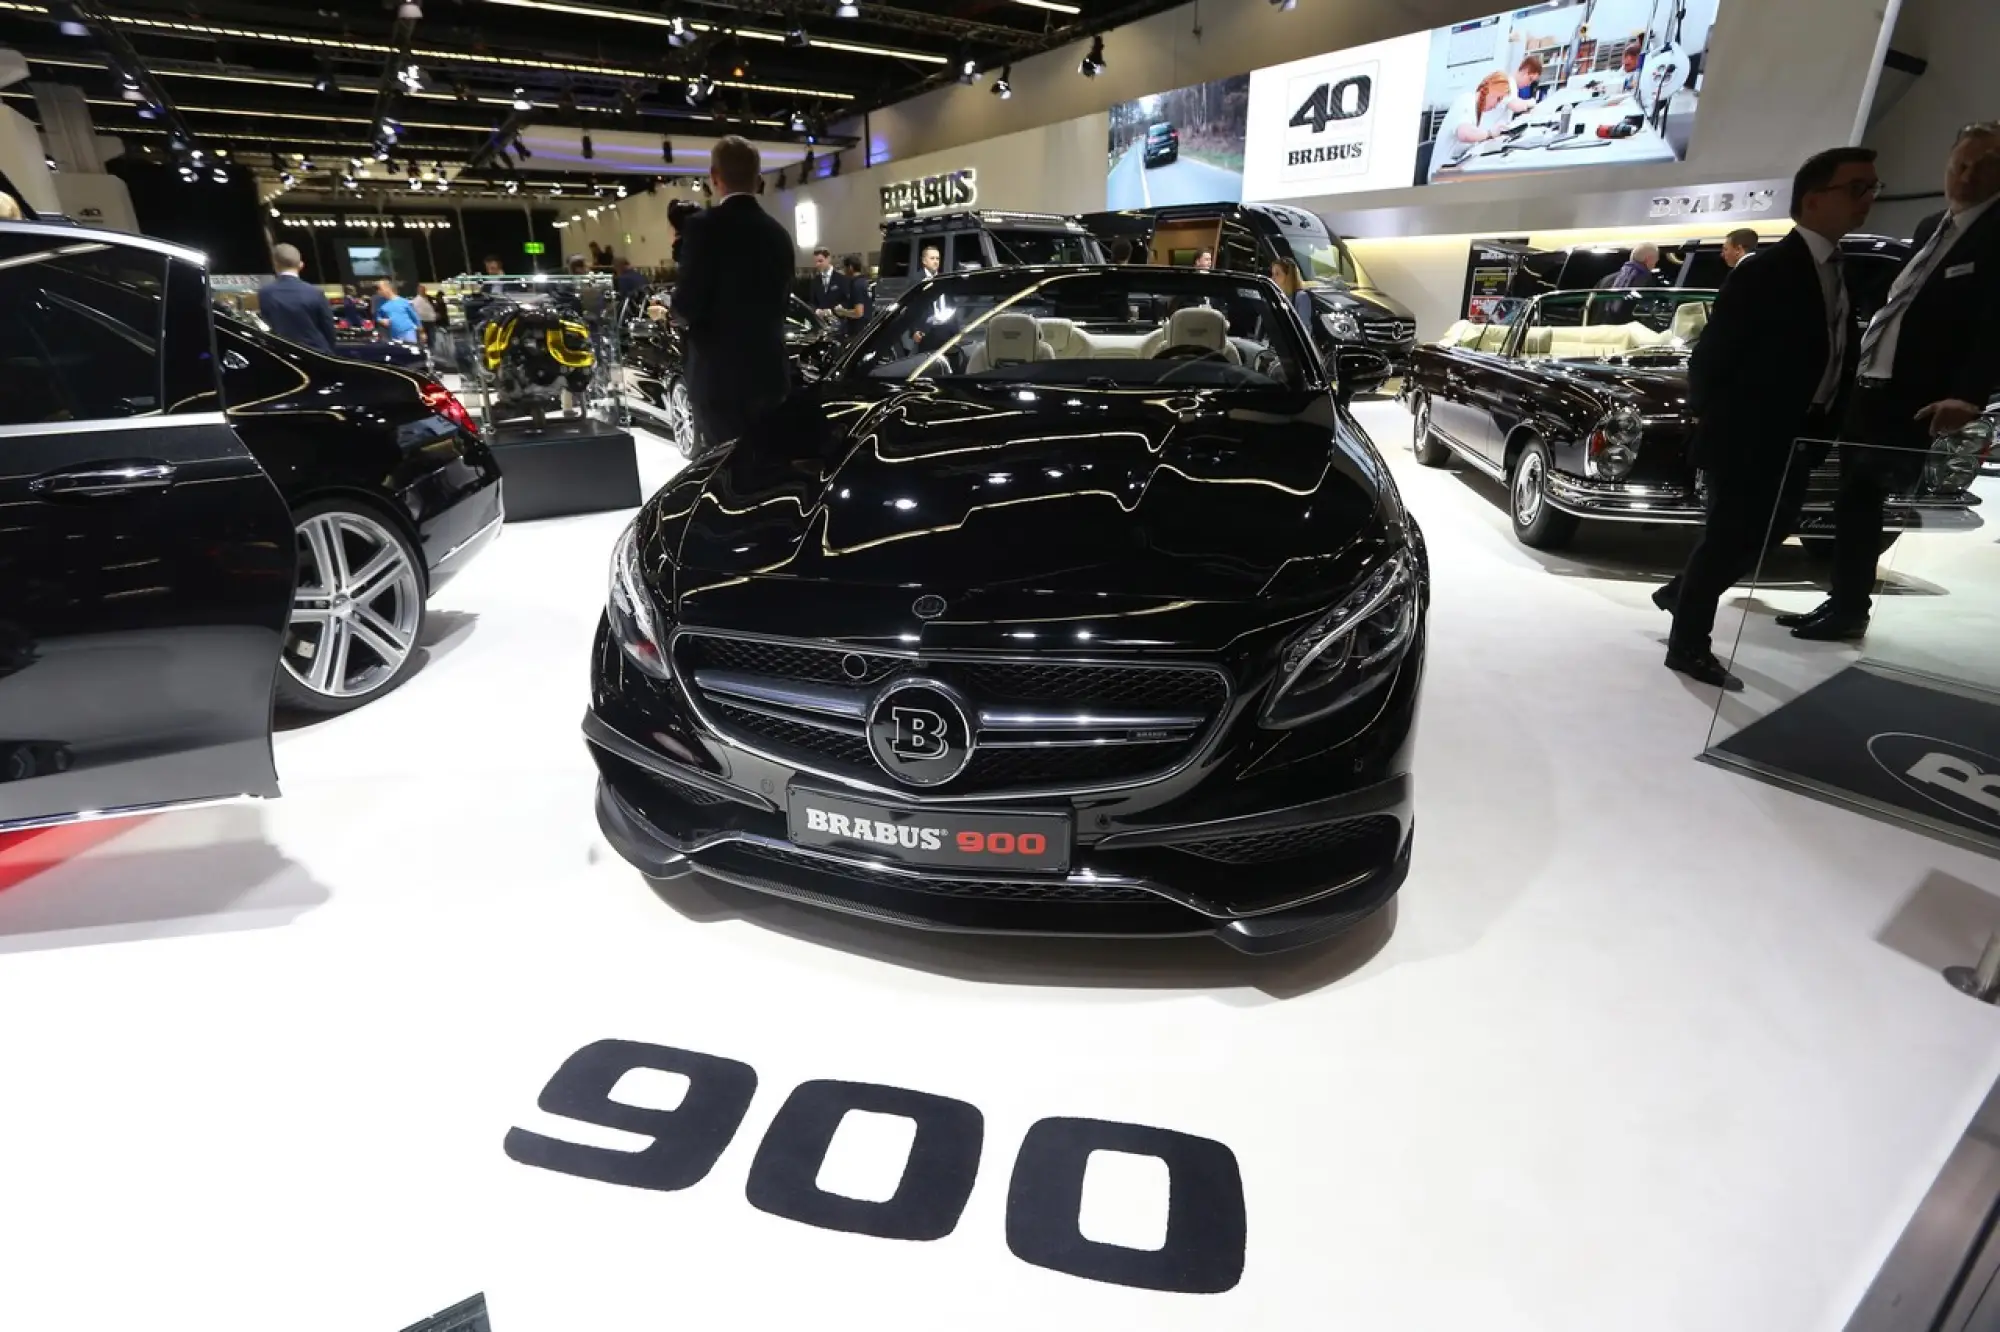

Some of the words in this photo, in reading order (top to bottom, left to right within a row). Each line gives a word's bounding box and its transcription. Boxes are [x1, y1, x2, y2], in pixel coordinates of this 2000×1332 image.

[1289, 75, 1371, 133] 40
[1287, 142, 1363, 166] BRABUS
[880, 168, 976, 216] BRABUS
[892, 706, 949, 760] B
[956, 831, 1046, 855] 900
[503, 1038, 1247, 1294] 900
